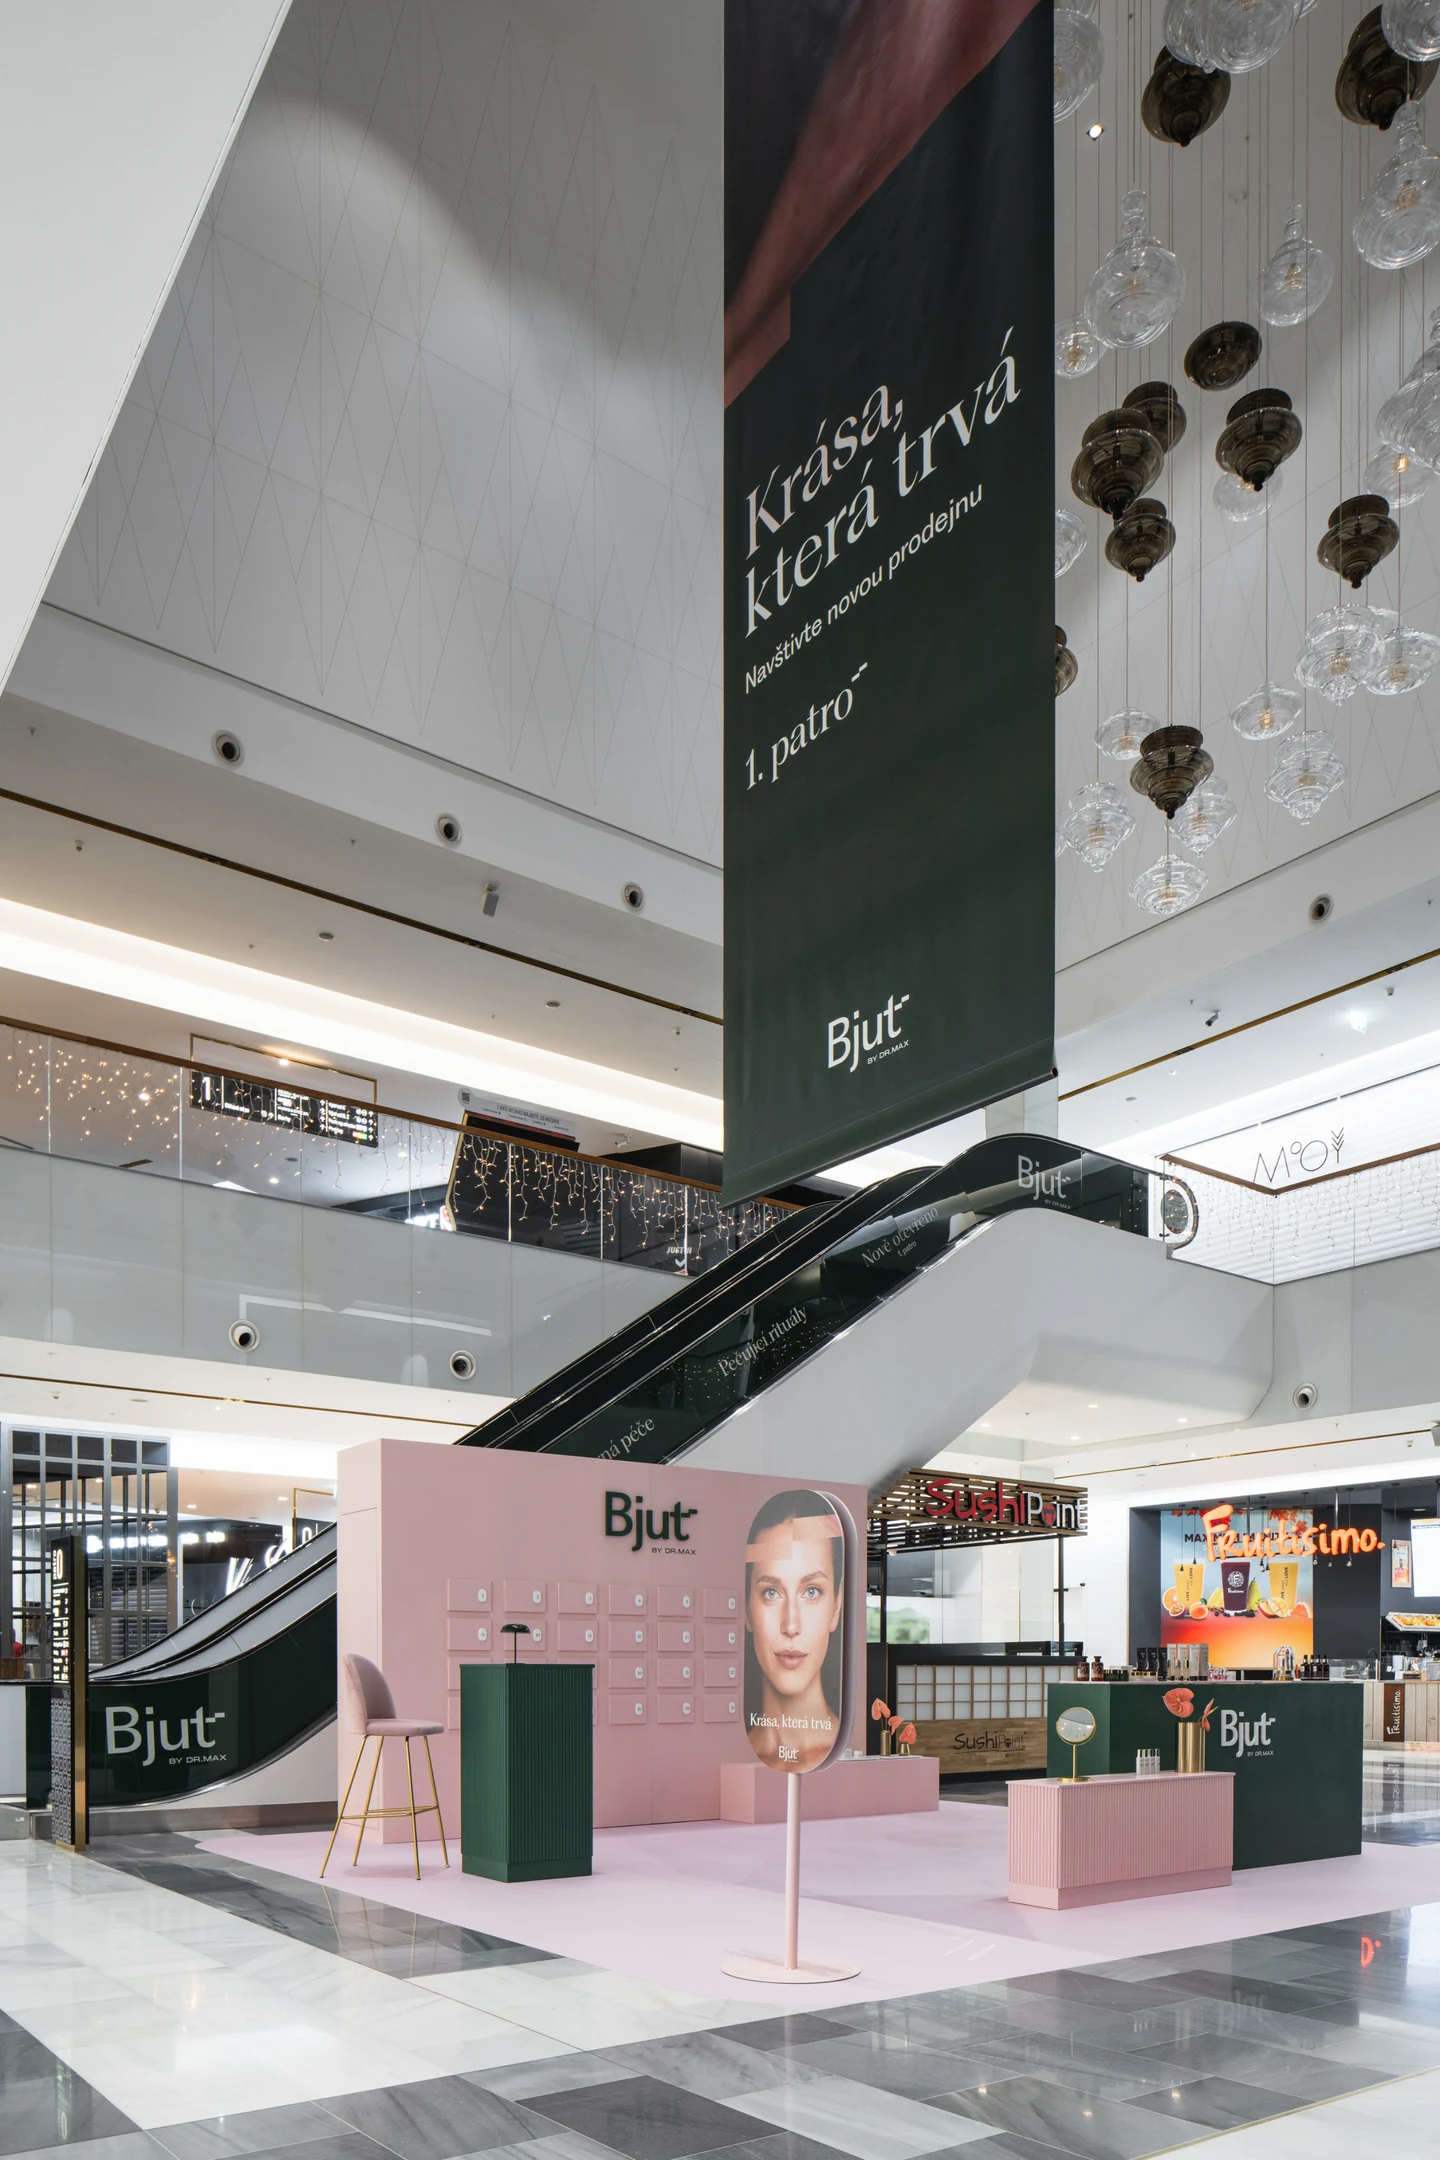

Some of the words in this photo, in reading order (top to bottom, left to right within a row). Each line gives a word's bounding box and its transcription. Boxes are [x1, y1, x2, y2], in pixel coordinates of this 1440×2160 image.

[745, 459, 879, 638] která
[893, 326, 1021, 497] trvá
[746, 385, 903, 559] Krása,
[746, 618, 822, 694] Navštivte
[828, 567, 883, 626] novou
[889, 484, 983, 581] prodejnu
[746, 749, 763, 790] 1.
[771, 663, 868, 783] patro
[828, 994, 910, 1073] Bjut
[867, 1055, 878, 1065] BY
[879, 1040, 910, 1059] DR.MAX
[1018, 1154, 1071, 1200] Bjut
[862, 1237, 892, 1268] Nově
[892, 1207, 939, 1246] otevřeno
[902, 1241, 917, 1256] patro
[718, 1330, 769, 1377] Pečující
[768, 1306, 807, 1342] rituály
[620, 1418, 655, 1453] péče
[605, 1491, 698, 1552] Bjut
[665, 1547, 697, 1556] DR.MAX
[105, 1706, 225, 1767] Bjut
[750, 1712, 780, 1730] Krása,
[781, 1713, 808, 1729] která
[811, 1716, 832, 1730] trvá
[1221, 1709, 1276, 1758] Bjut
[168, 1757, 183, 1765] BY
[186, 1754, 227, 1763] DR.MAX
